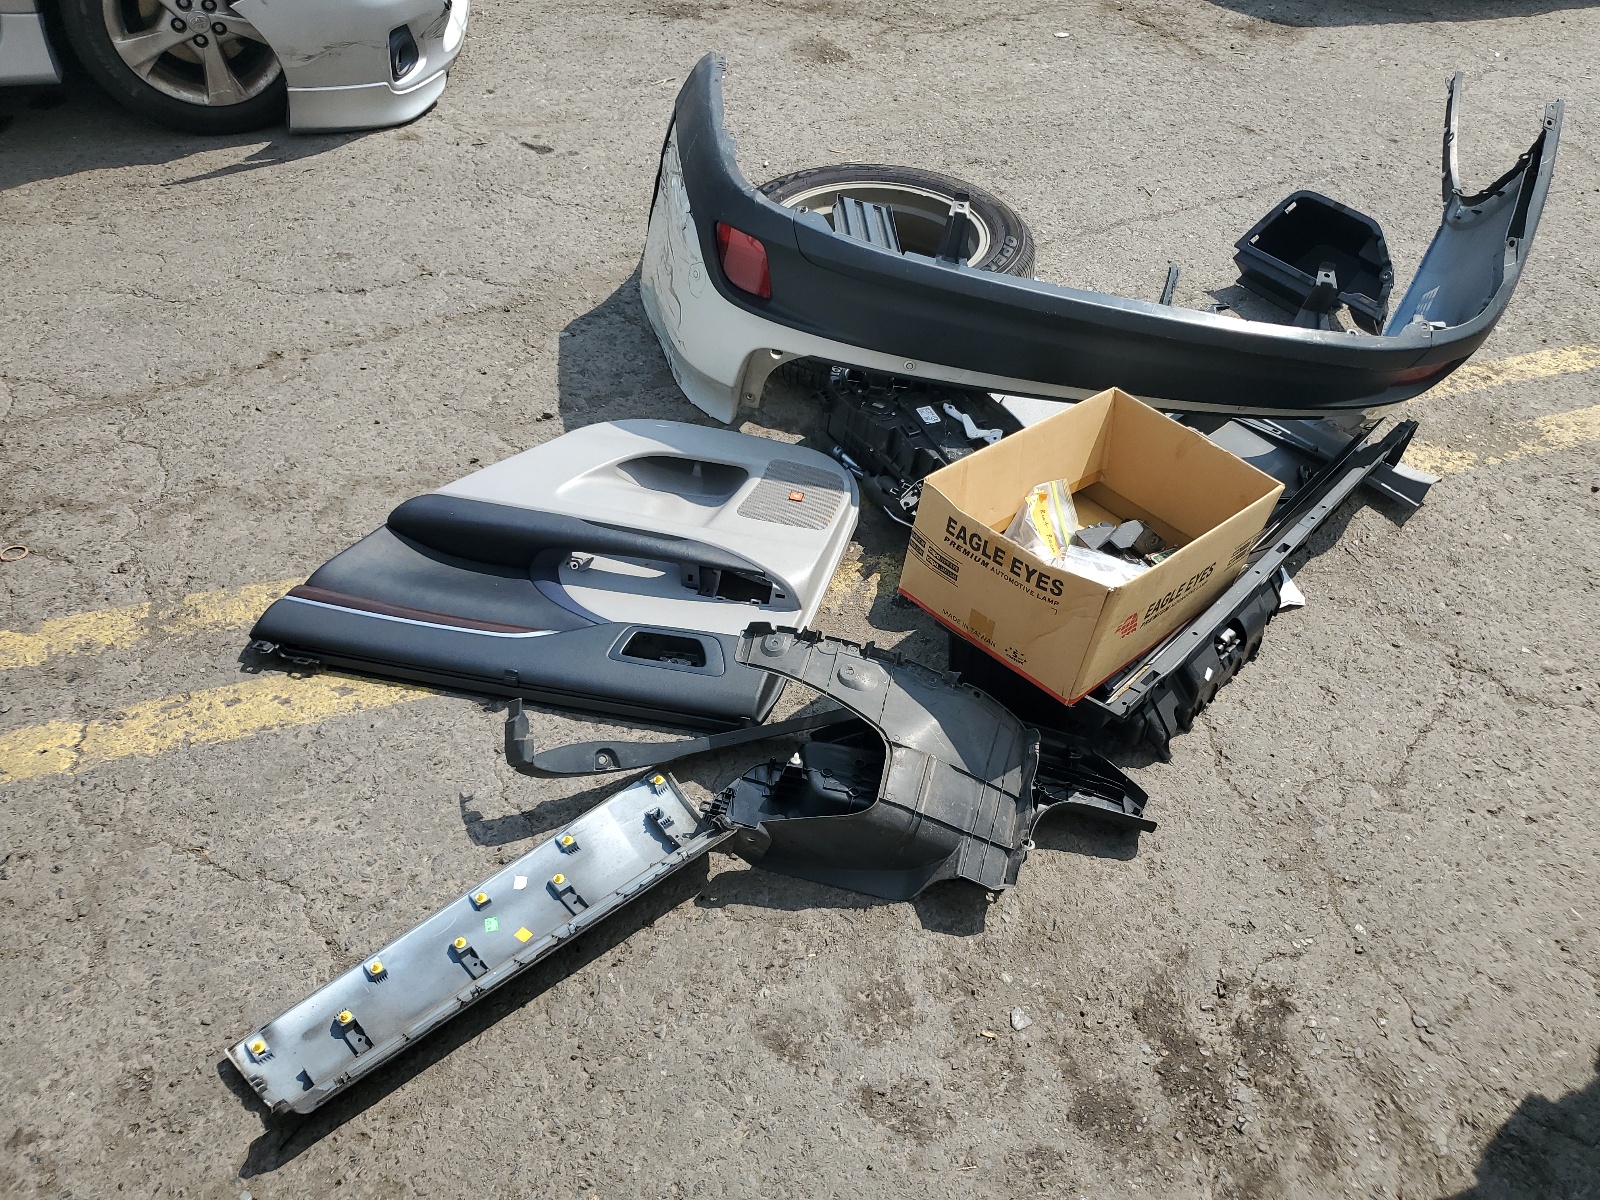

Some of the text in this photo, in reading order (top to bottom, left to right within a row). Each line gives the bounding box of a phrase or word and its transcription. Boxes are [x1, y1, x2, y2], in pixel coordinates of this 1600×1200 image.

[944, 536, 989, 568] PREMIUM
[990, 566, 1035, 597] AUTOMOTIVE
[1036, 593, 1060, 606] LAMP
[946, 516, 1005, 567] EAGLE
[1010, 557, 1064, 596] EYES
[942, 608, 961, 625] MADE
[1144, 582, 1187, 620] EAGLE
[1184, 562, 1217, 593] EYES
